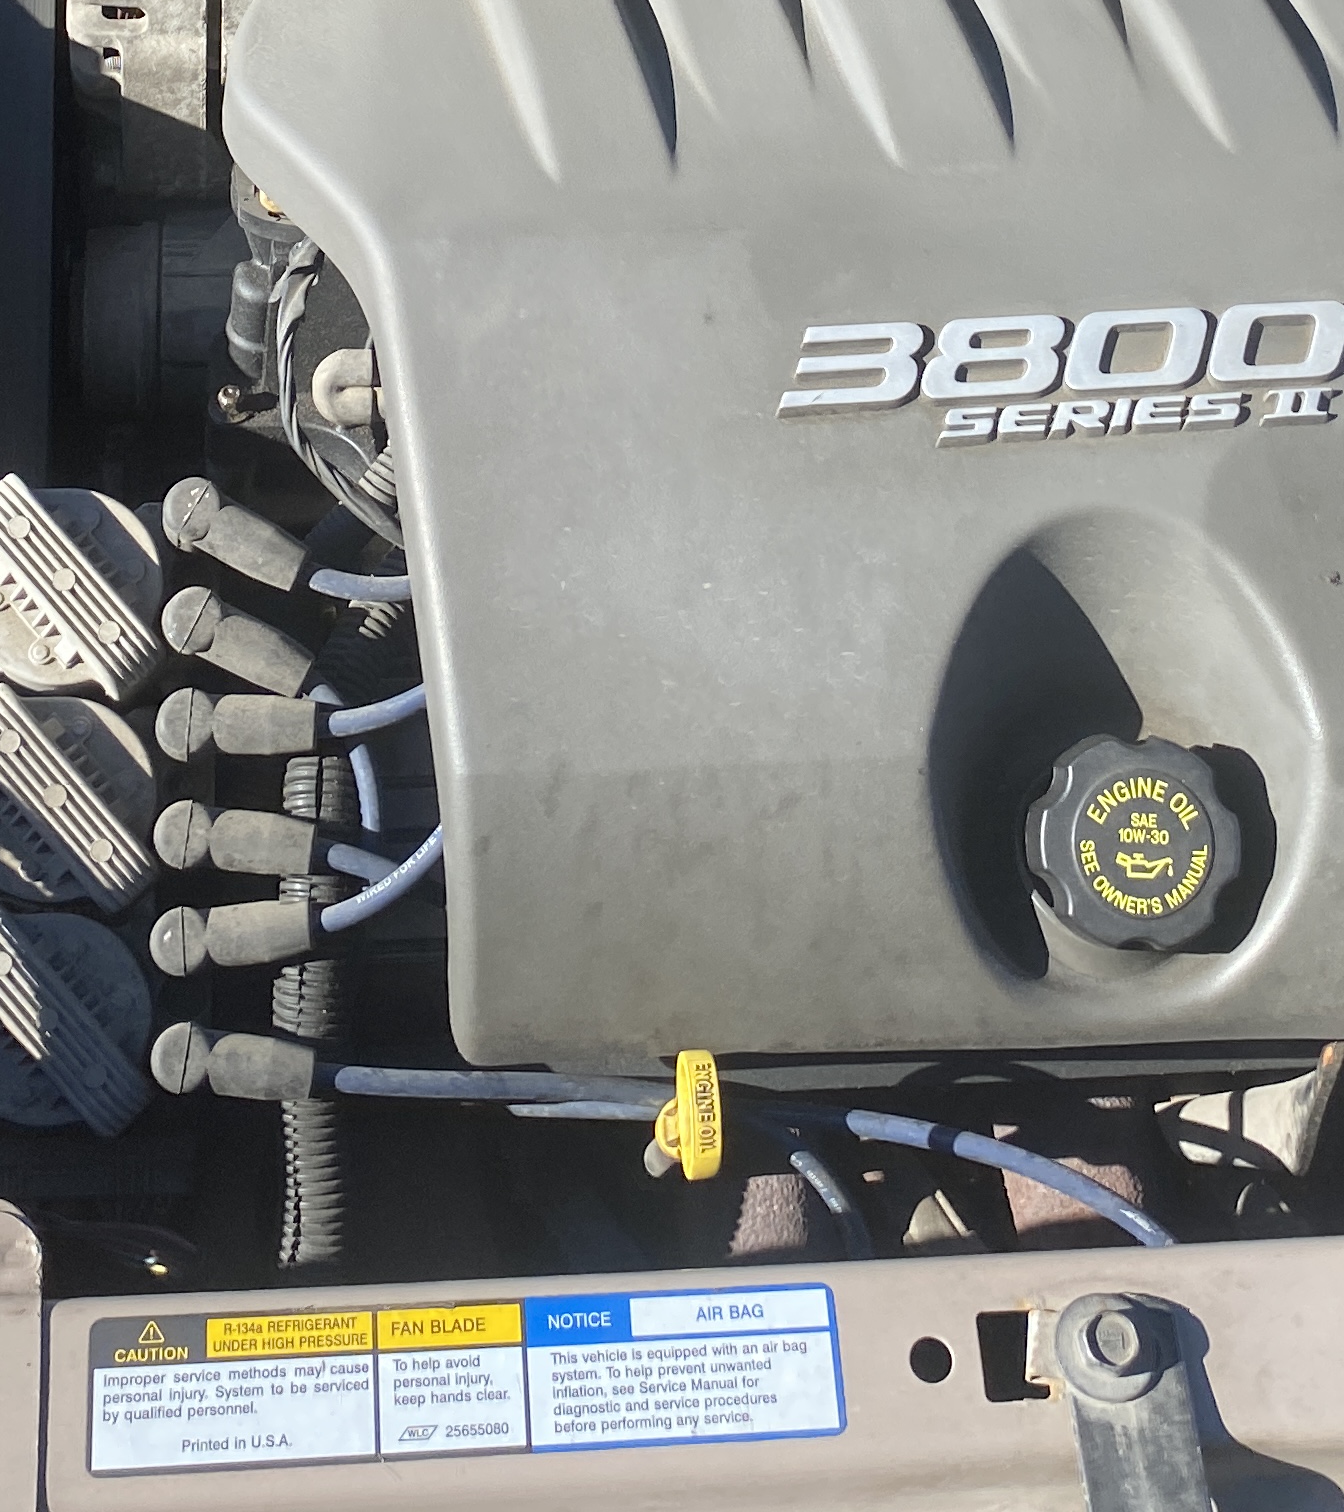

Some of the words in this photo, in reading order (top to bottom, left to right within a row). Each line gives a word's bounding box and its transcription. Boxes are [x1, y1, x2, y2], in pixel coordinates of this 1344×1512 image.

[937, 392, 1247, 448] SERIES
[1259, 388, 1342, 427] II
[1087, 777, 1168, 825] ENGINE
[1170, 793, 1198, 831] OIL
[1130, 813, 1158, 828] SAE
[1118, 828, 1169, 845] 10W-30
[357, 877, 392, 904] WIRED
[393, 859, 415, 879] FOR
[1080, 840, 1101, 876] SEE
[1093, 875, 1163, 915] OWNER'S
[1164, 845, 1208, 909] MANUAL
[695, 1063, 717, 1122] ENGINE
[698, 1126, 717, 1153] OIL
[547, 1311, 612, 1330] NOTICE
[695, 1306, 725, 1322] AIR
[729, 1304, 764, 1320] BAG
[223, 1321, 263, 1335] R-134a
[267, 1317, 357, 1333] REFRIGERANT
[390, 1319, 426, 1336] FAN
[430, 1317, 487, 1335] BLADE
[213, 1338, 258, 1353] UNDER
[262, 1335, 295, 1349] HIGH
[299, 1333, 368, 1348] PRESSURE
[550, 1351, 578, 1366] This
[582, 1348, 627, 1364] vehicle
[632, 1349, 643, 1362] is
[647, 1343, 707, 1363] equipped
[711, 1343, 737, 1357] with
[742, 1343, 758, 1355] an
[762, 1340, 779, 1354] air
[782, 1338, 807, 1357] bag
[114, 1346, 189, 1363] CAUTION
[393, 1359, 407, 1371] To
[412, 1357, 440, 1372] help
[445, 1355, 480, 1368] avoid
[104, 1374, 166, 1388] Improper
[173, 1370, 221, 1382] service
[228, 1365, 287, 1381] methods
[330, 1363, 369, 1375] cause
[551, 1367, 602, 1382] system.
[606, 1365, 621, 1378] To
[625, 1364, 653, 1380] help
[658, 1361, 706, 1378] prevent
[709, 1358, 772, 1374] unwanted
[103, 1390, 163, 1407] personal
[169, 1388, 208, 1404] injury.
[215, 1384, 264, 1400] System
[271, 1383, 284, 1395] to
[290, 1381, 307, 1394] be
[313, 1378, 369, 1393] serviced
[393, 1373, 450, 1391] personal
[552, 1385, 607, 1401] inflation,
[611, 1383, 635, 1397] see
[639, 1379, 687, 1394] Service
[691, 1377, 737, 1392] Manual
[741, 1375, 759, 1388] for
[394, 1391, 426, 1408] keep
[431, 1389, 472, 1404] hands
[476, 1388, 510, 1401] clear.
[553, 1401, 621, 1420] diagnostic
[625, 1400, 649, 1414] and
[654, 1397, 699, 1412] service
[703, 1392, 777, 1410] procedures
[102, 1409, 119, 1424] by
[124, 1406, 182, 1423] qualified
[187, 1402, 258, 1420] personnel.
[554, 1419, 596, 1433] before
[601, 1415, 672, 1433] performing
[676, 1415, 699, 1429] any
[703, 1411, 753, 1426] service.
[407, 1428, 429, 1437] WLC
[446, 1422, 509, 1437] 25655080
[182, 1437, 229, 1453] Printed
[234, 1435, 246, 1450] in
[251, 1434, 293, 1448] U.S.A.
